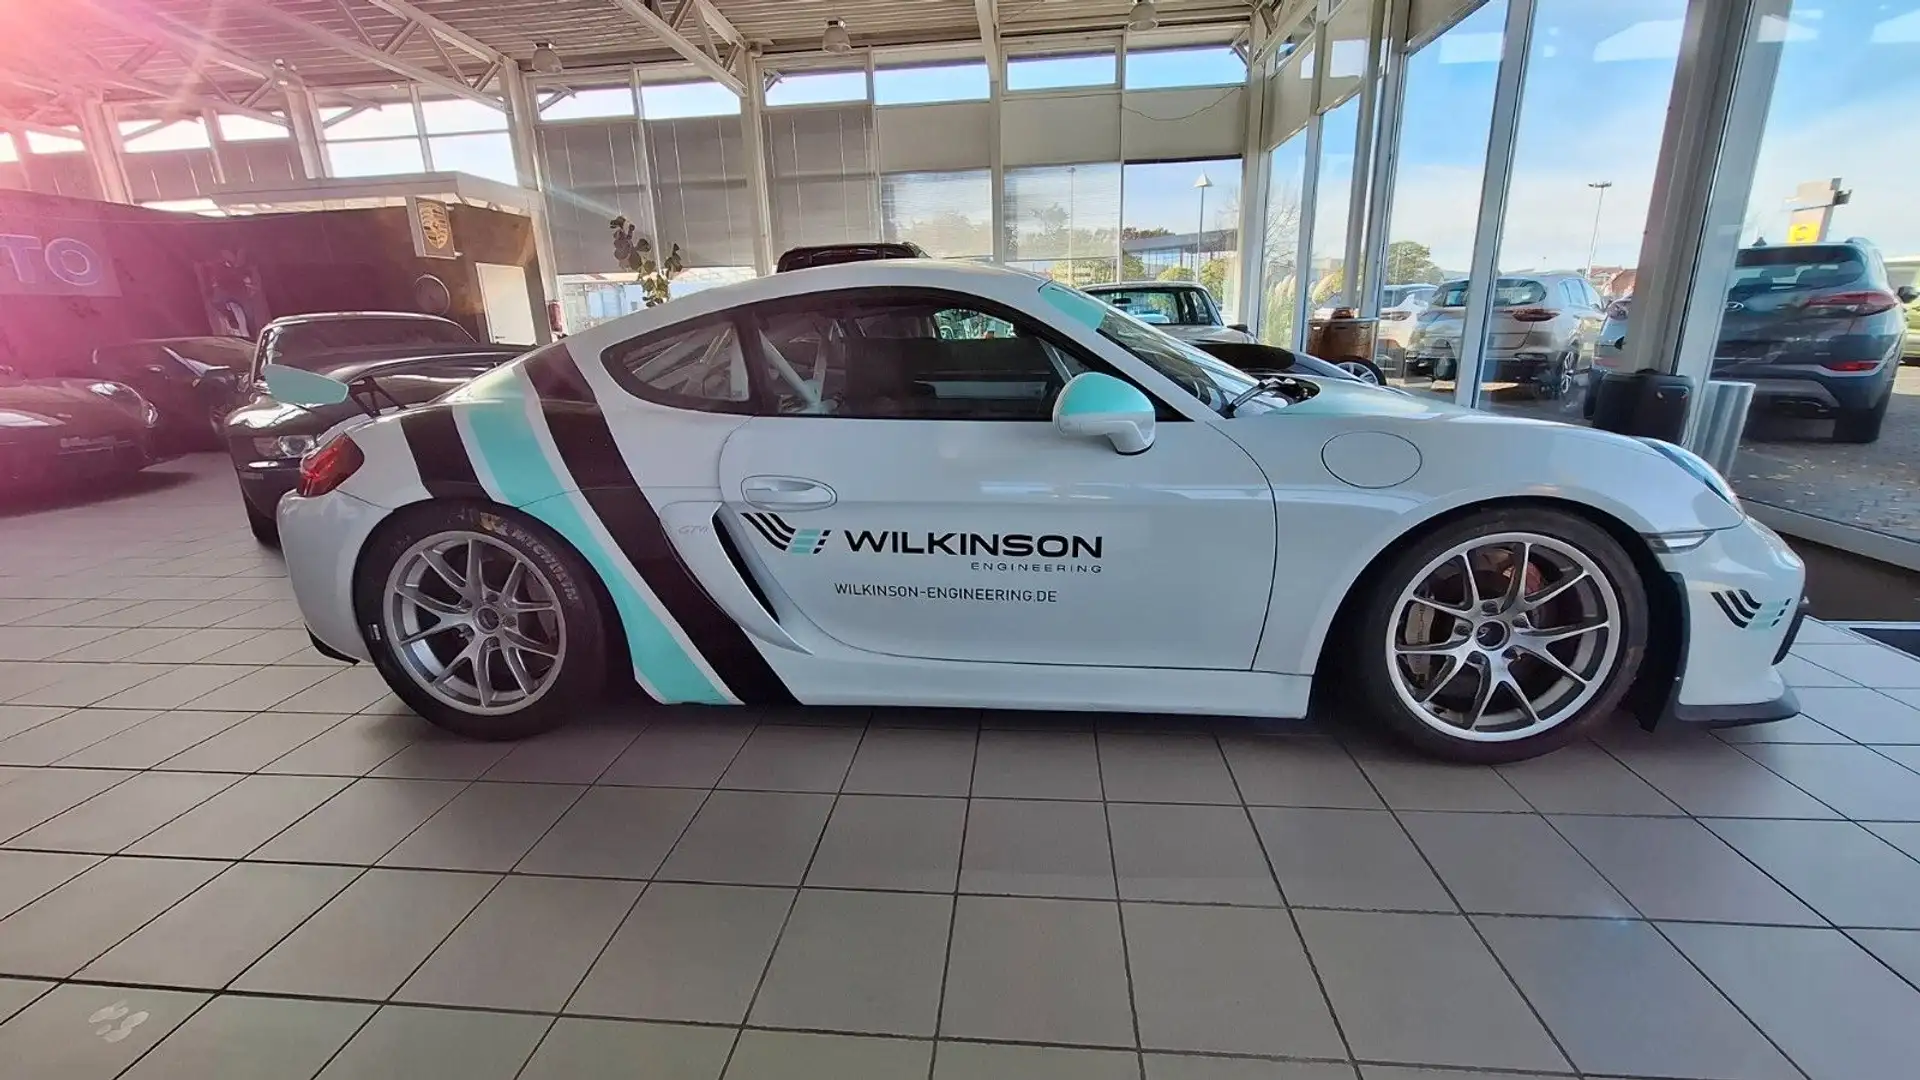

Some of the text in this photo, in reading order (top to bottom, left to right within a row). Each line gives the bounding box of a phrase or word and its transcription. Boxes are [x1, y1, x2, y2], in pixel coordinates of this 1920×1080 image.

[844, 529, 1103, 559] WILKINSON
[970, 561, 1103, 574] ENGINEERING
[834, 583, 1058, 603] WILKINSON-ENGINEERING.DE
